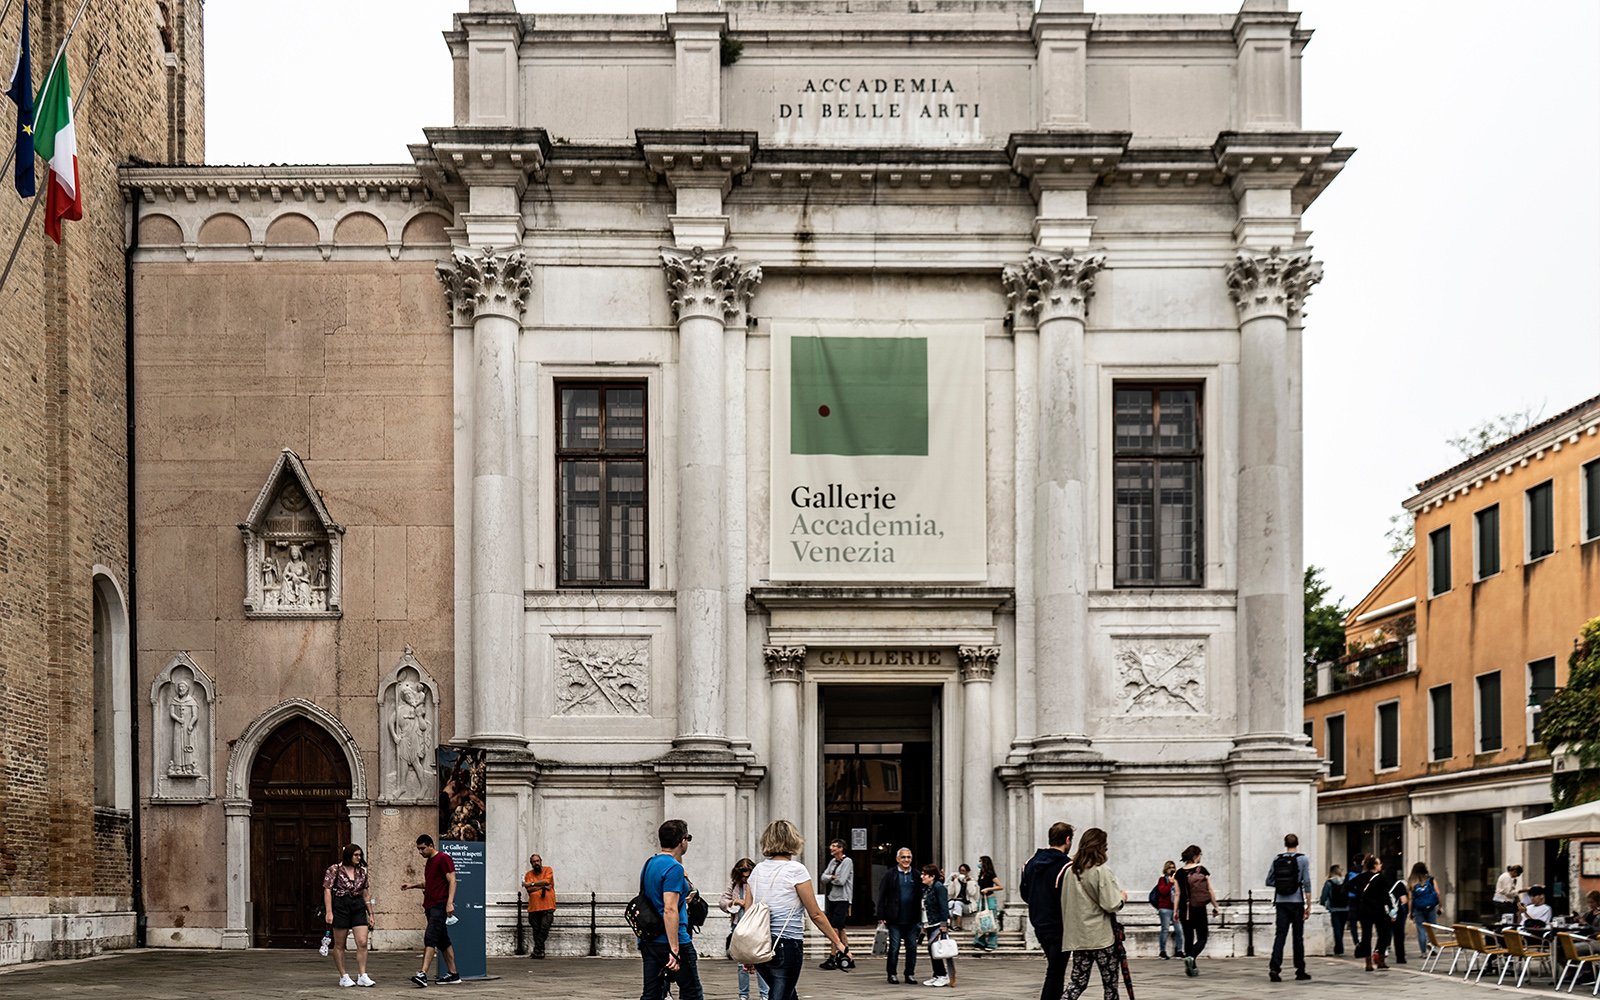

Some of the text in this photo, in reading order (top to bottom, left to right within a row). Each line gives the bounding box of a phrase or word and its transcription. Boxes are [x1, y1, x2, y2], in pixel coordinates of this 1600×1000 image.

[804, 78, 955, 93] ACCADEMIA
[779, 103, 980, 118] DI BELLE ARTI
[790, 483, 897, 510] Gallerie
[789, 512, 945, 539] Accademia,
[790, 540, 896, 563] Venezia
[819, 650, 942, 666] GALLERIE
